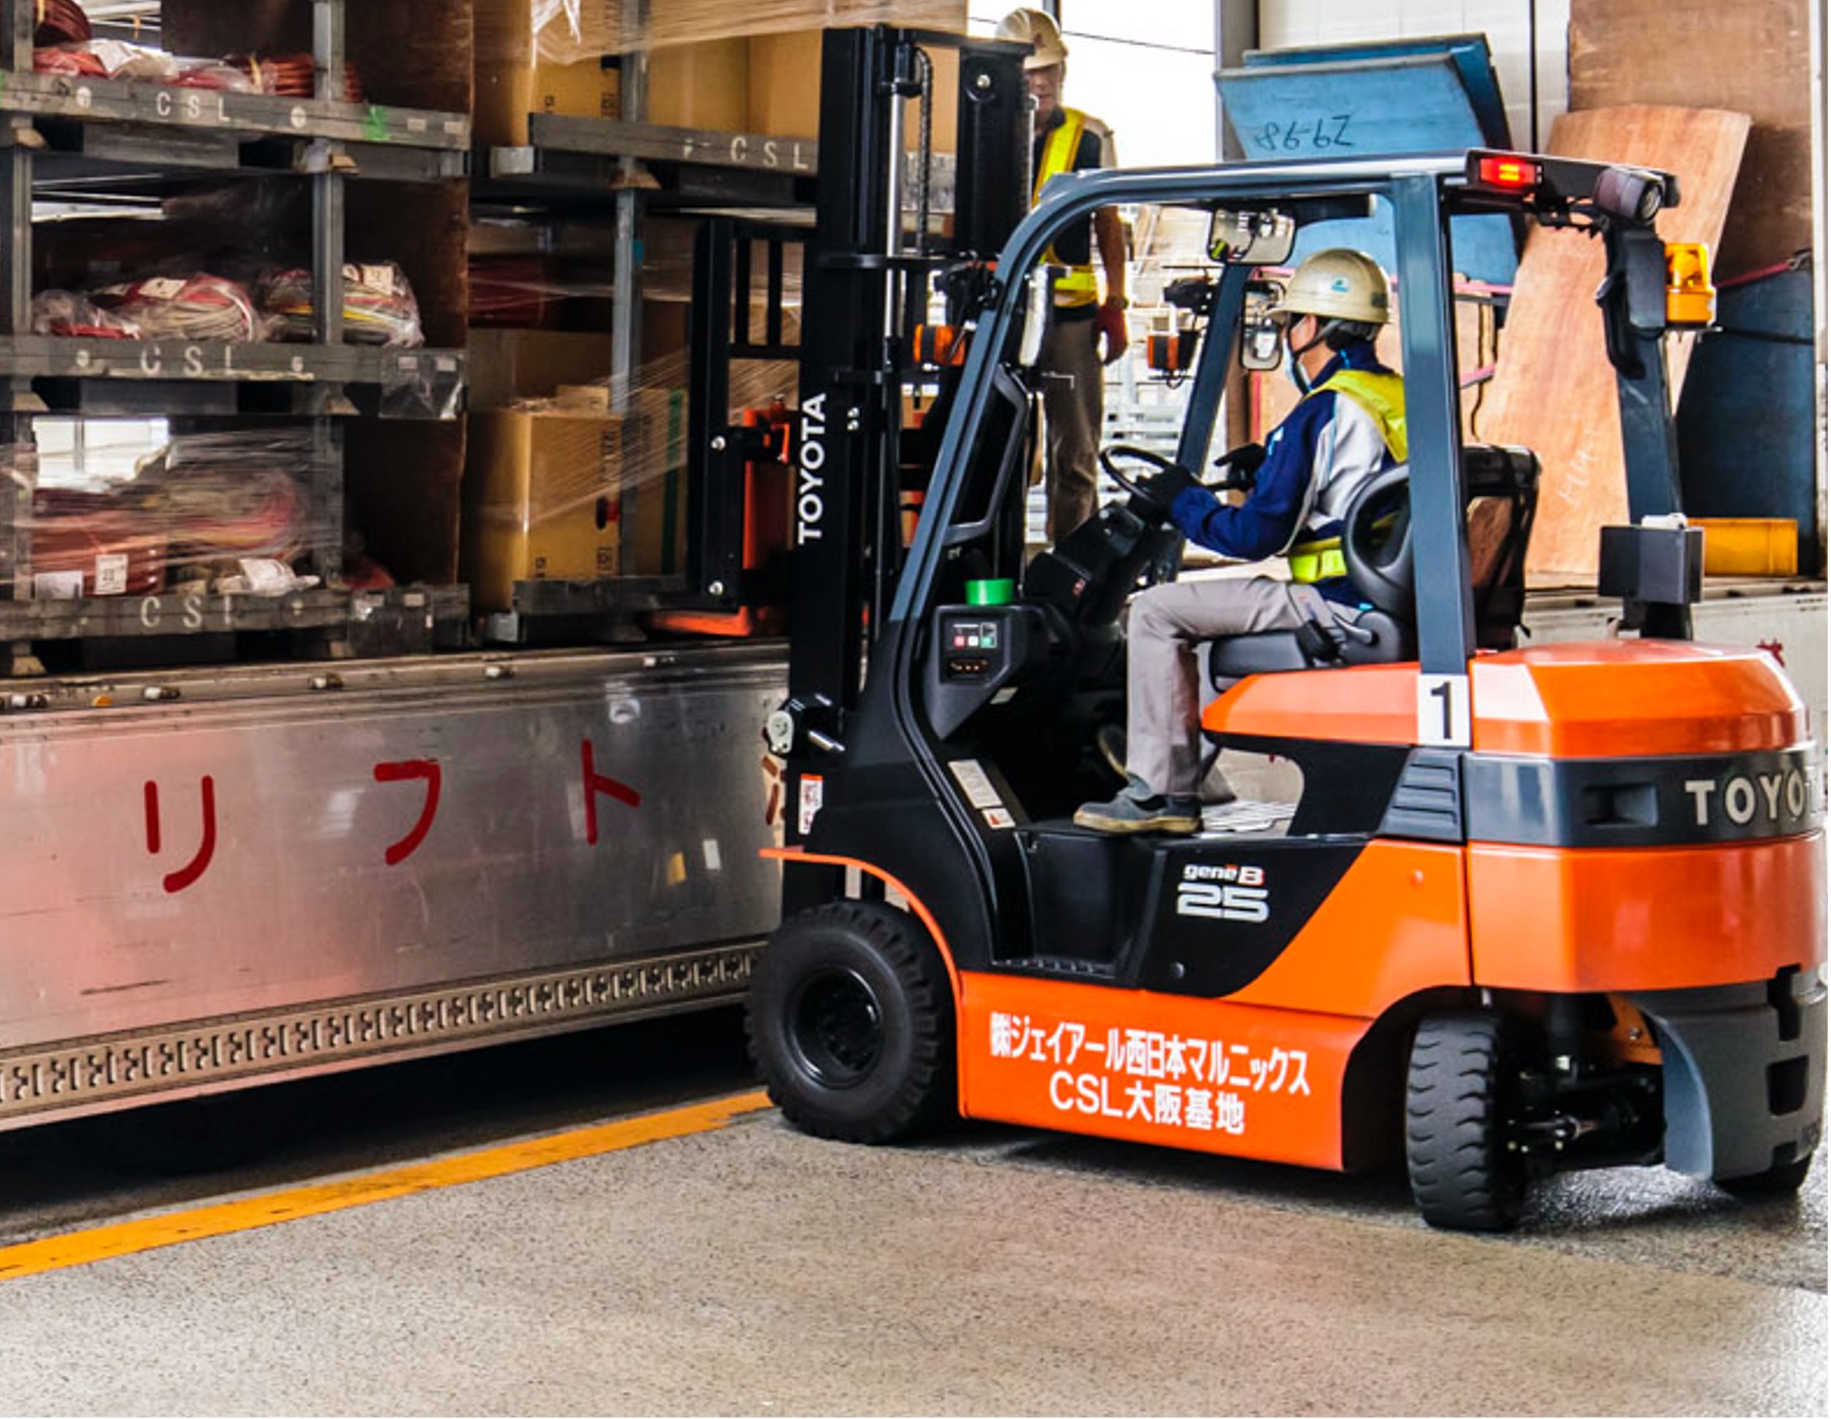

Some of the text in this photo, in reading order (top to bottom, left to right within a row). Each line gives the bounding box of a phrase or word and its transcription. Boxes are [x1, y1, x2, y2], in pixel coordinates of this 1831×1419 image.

[157, 91, 231, 123] CSL
[730, 137, 809, 170] CSL
[140, 346, 235, 378] CSL
[797, 393, 827, 545] TOYOTA
[1430, 681, 1453, 740] 1
[1685, 769, 1810, 826] TOYO
[1176, 882, 1270, 923] 25
[1049, 1070, 1246, 1135] CSL大阪基地
